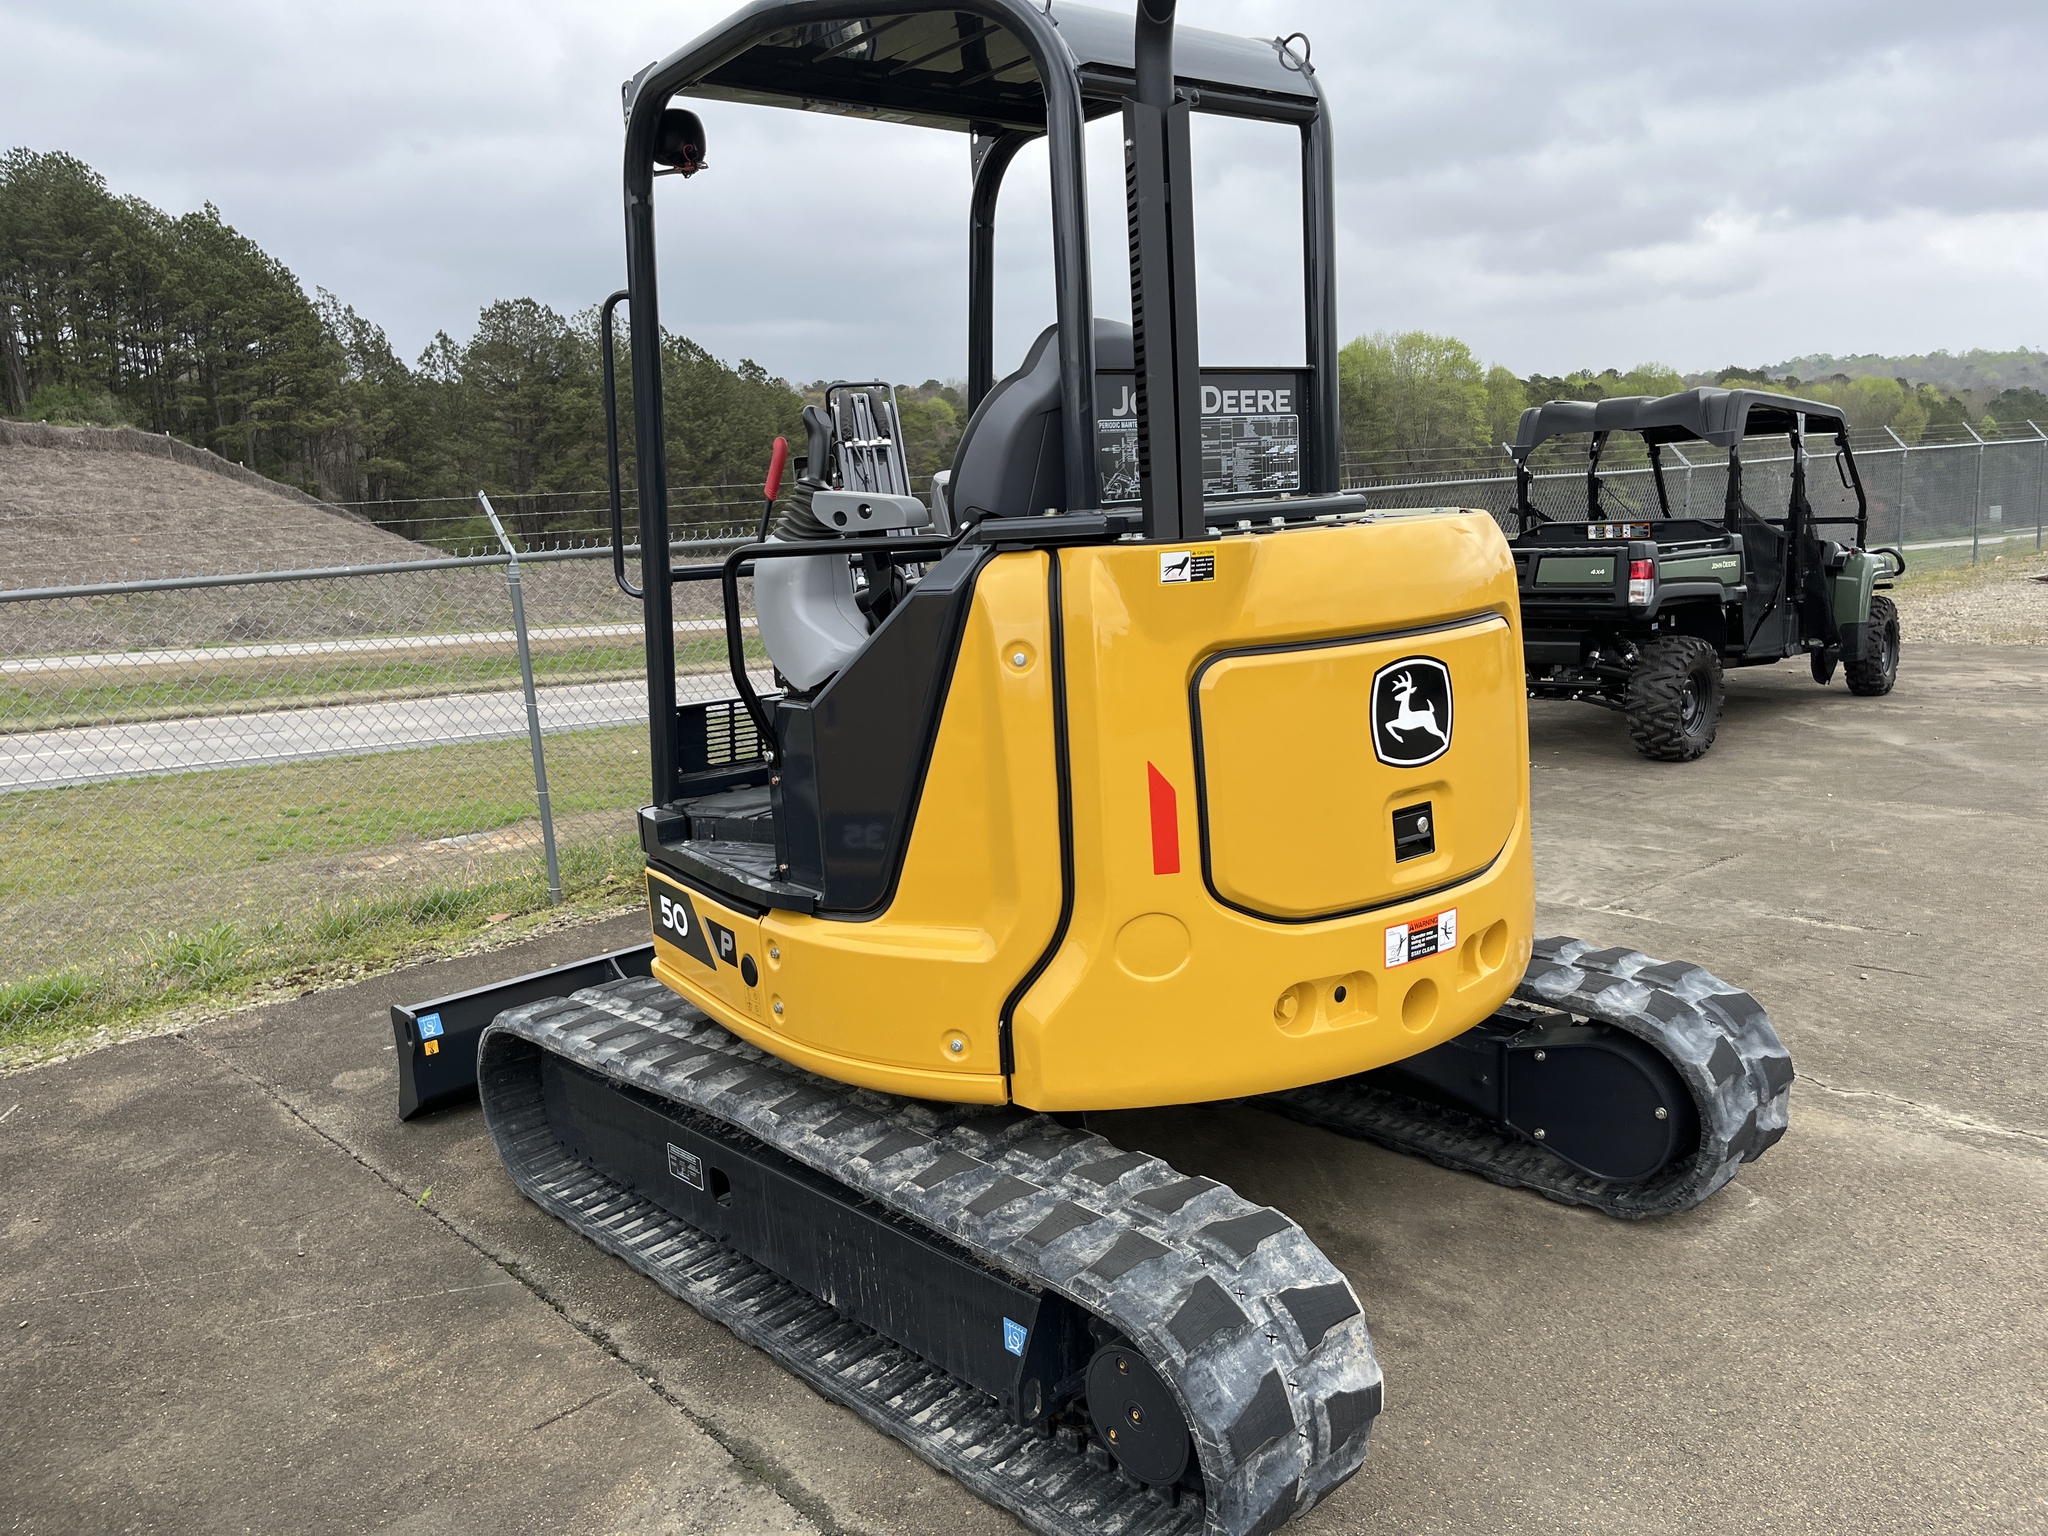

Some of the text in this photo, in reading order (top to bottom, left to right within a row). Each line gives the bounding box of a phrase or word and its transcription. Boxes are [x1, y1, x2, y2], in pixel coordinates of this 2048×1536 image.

[1200, 385, 1292, 414] DEERE
[1098, 421, 1120, 429] PERIODIC
[660, 894, 733, 957] 50 P
[1414, 916, 1438, 930] WARNING
[1410, 944, 1436, 958] STAY CLEAR
